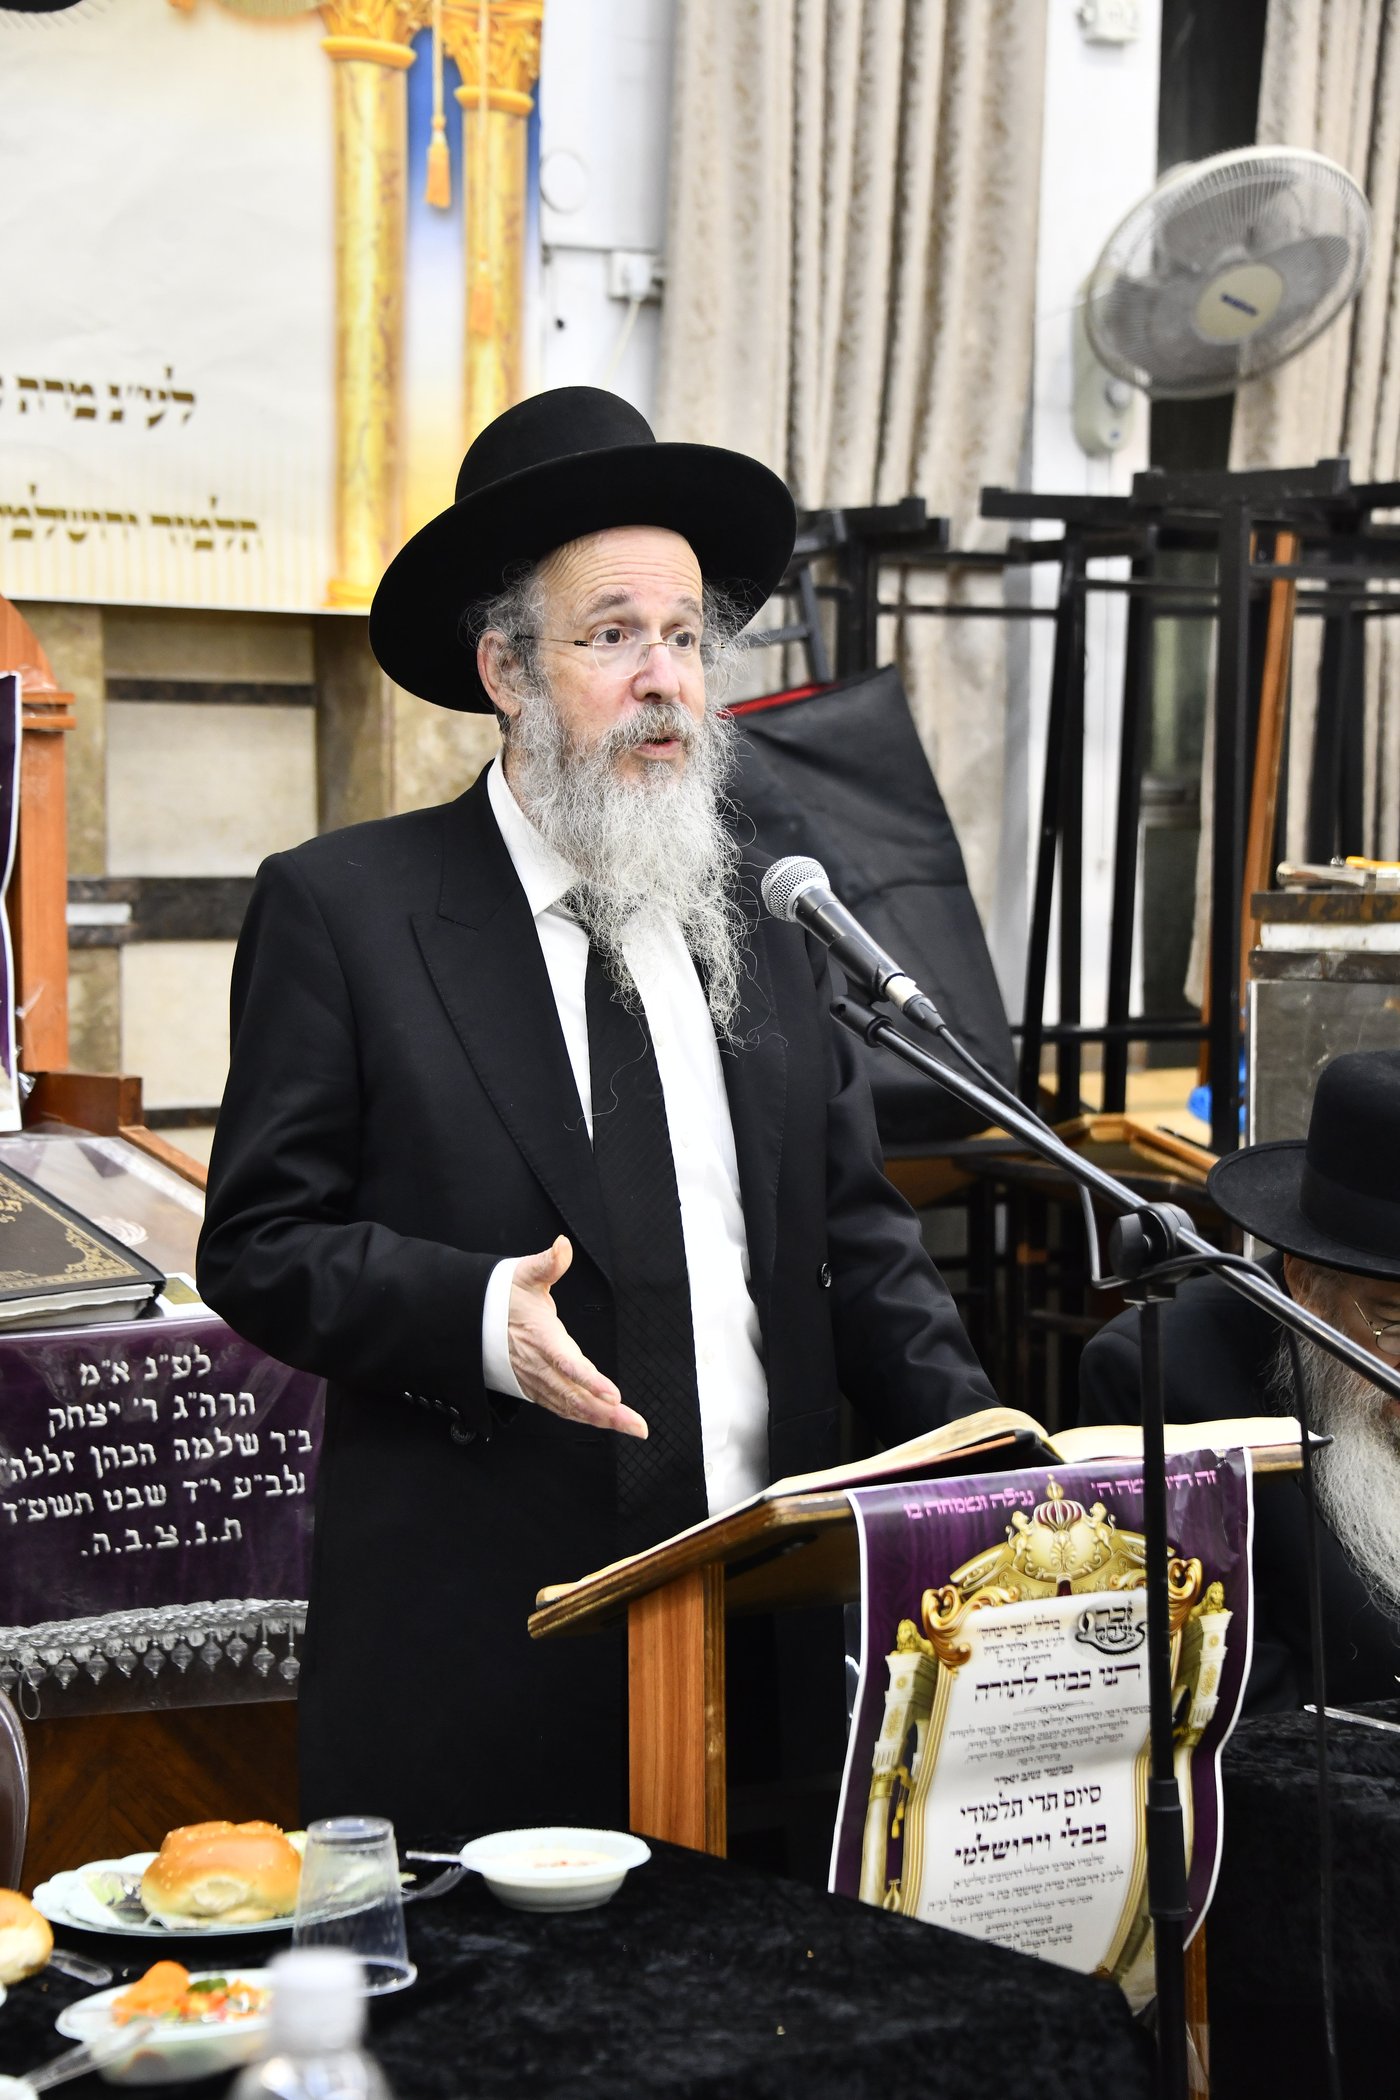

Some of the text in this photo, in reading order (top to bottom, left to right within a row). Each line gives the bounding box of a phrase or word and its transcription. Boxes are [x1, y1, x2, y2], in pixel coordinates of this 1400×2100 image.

[0, 483, 262, 553] תלמוד ירושלמ
[80, 1344, 212, 1386] לע"נ א"מ
[48, 1391, 256, 1438] הרה"ג ר' יצחק
[173, 1427, 260, 1461] שלמה
[270, 1429, 313, 1454] ב"ר
[90, 1442, 157, 1479] הכהן
[2, 1464, 306, 1525] נלב"ע י"ד שבט תשע"ד
[1115, 1478, 1145, 1496] שה
[1165, 1473, 1194, 1490] היו
[1194, 1470, 1217, 1487] זה
[903, 1502, 923, 1519] בו
[923, 1495, 989, 1517] ונשמחה
[1034, 1614, 1060, 1631] כולל
[974, 1665, 1039, 1701] לתורה
[1045, 1670, 1092, 1691] כבוד
[960, 1785, 1102, 1824] סיום תרי תלמודי
[955, 1816, 1107, 1867] בבלי וירושלמי
